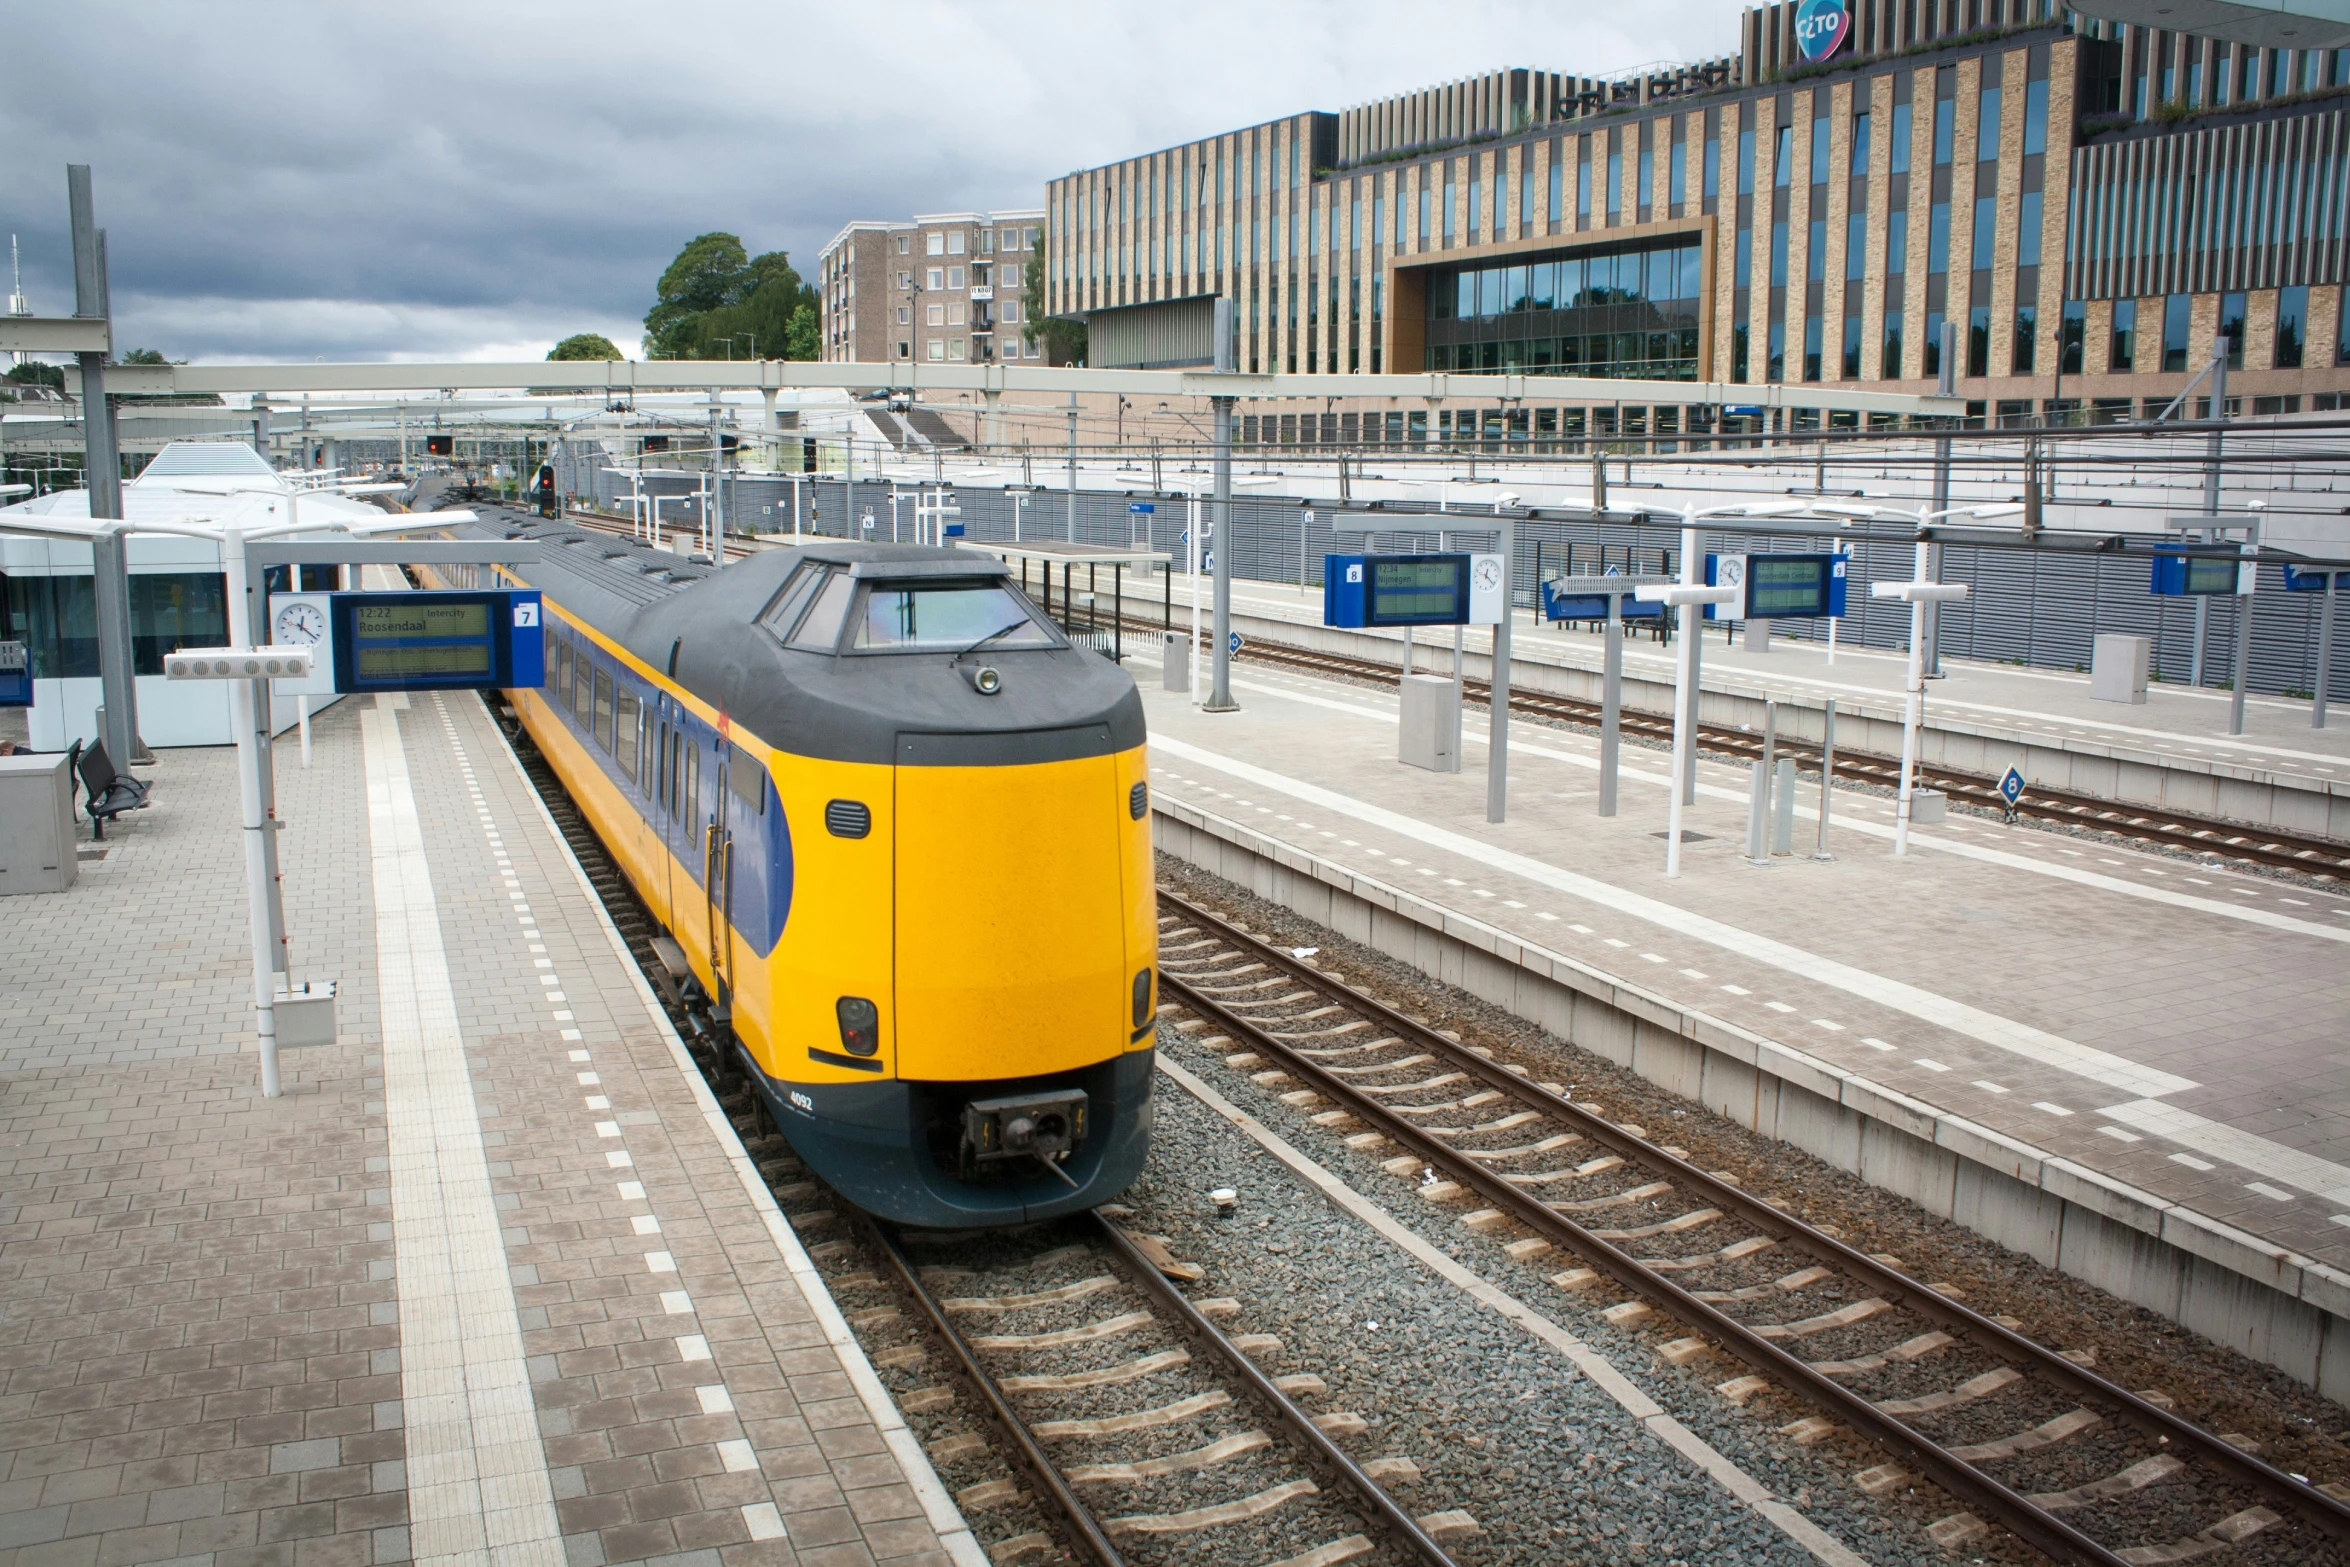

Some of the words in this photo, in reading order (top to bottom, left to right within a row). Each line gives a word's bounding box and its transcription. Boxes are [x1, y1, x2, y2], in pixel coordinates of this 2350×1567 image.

[1378, 564, 1398, 573] 12:34
[1836, 567, 1842, 576] 9
[1351, 571, 1358, 581] 8
[1378, 575, 1412, 585] Nijmegen
[359, 607, 391, 618] 12:22
[427, 608, 465, 619] Intercity
[521, 611, 531, 624] 7
[359, 620, 426, 633] Roosendaal
[2008, 777, 2018, 794] 8
[790, 1090, 813, 1111] 4092
